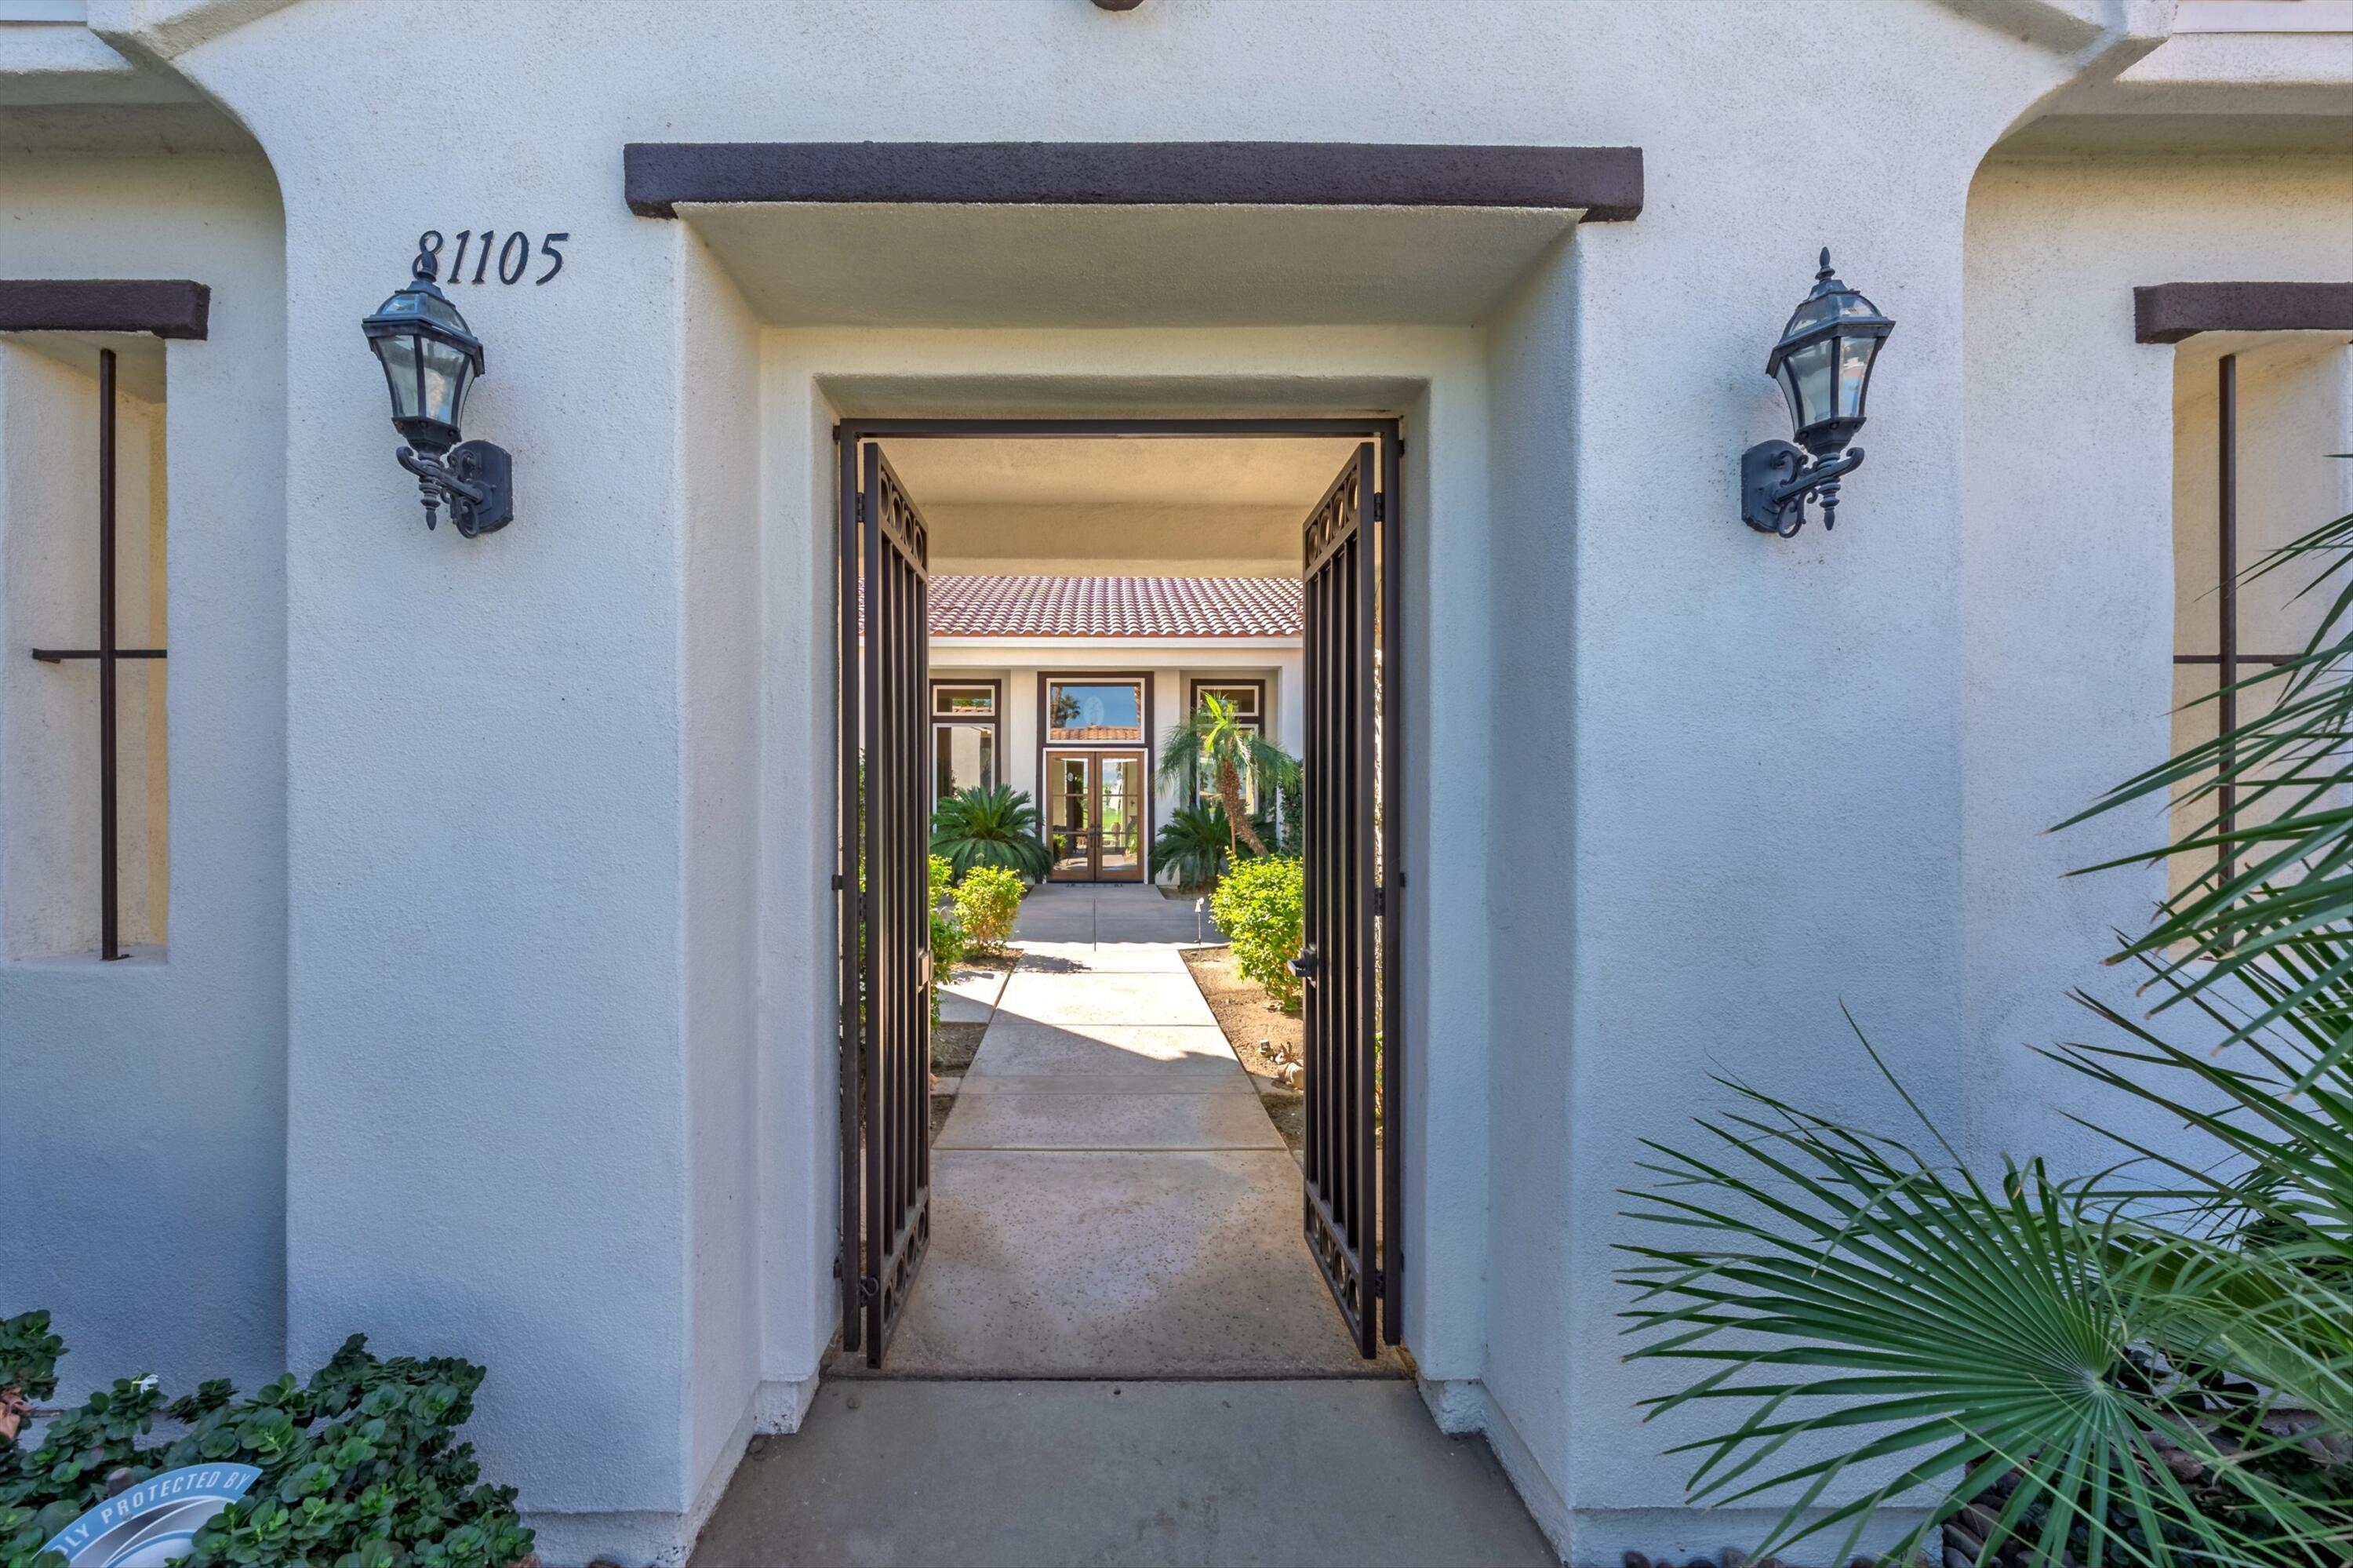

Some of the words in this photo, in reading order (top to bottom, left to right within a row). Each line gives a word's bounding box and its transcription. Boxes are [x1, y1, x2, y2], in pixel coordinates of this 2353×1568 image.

[412, 230, 569, 286] 81105
[100, 1472, 221, 1524] PROTECTED
[224, 1472, 251, 1490] BY
